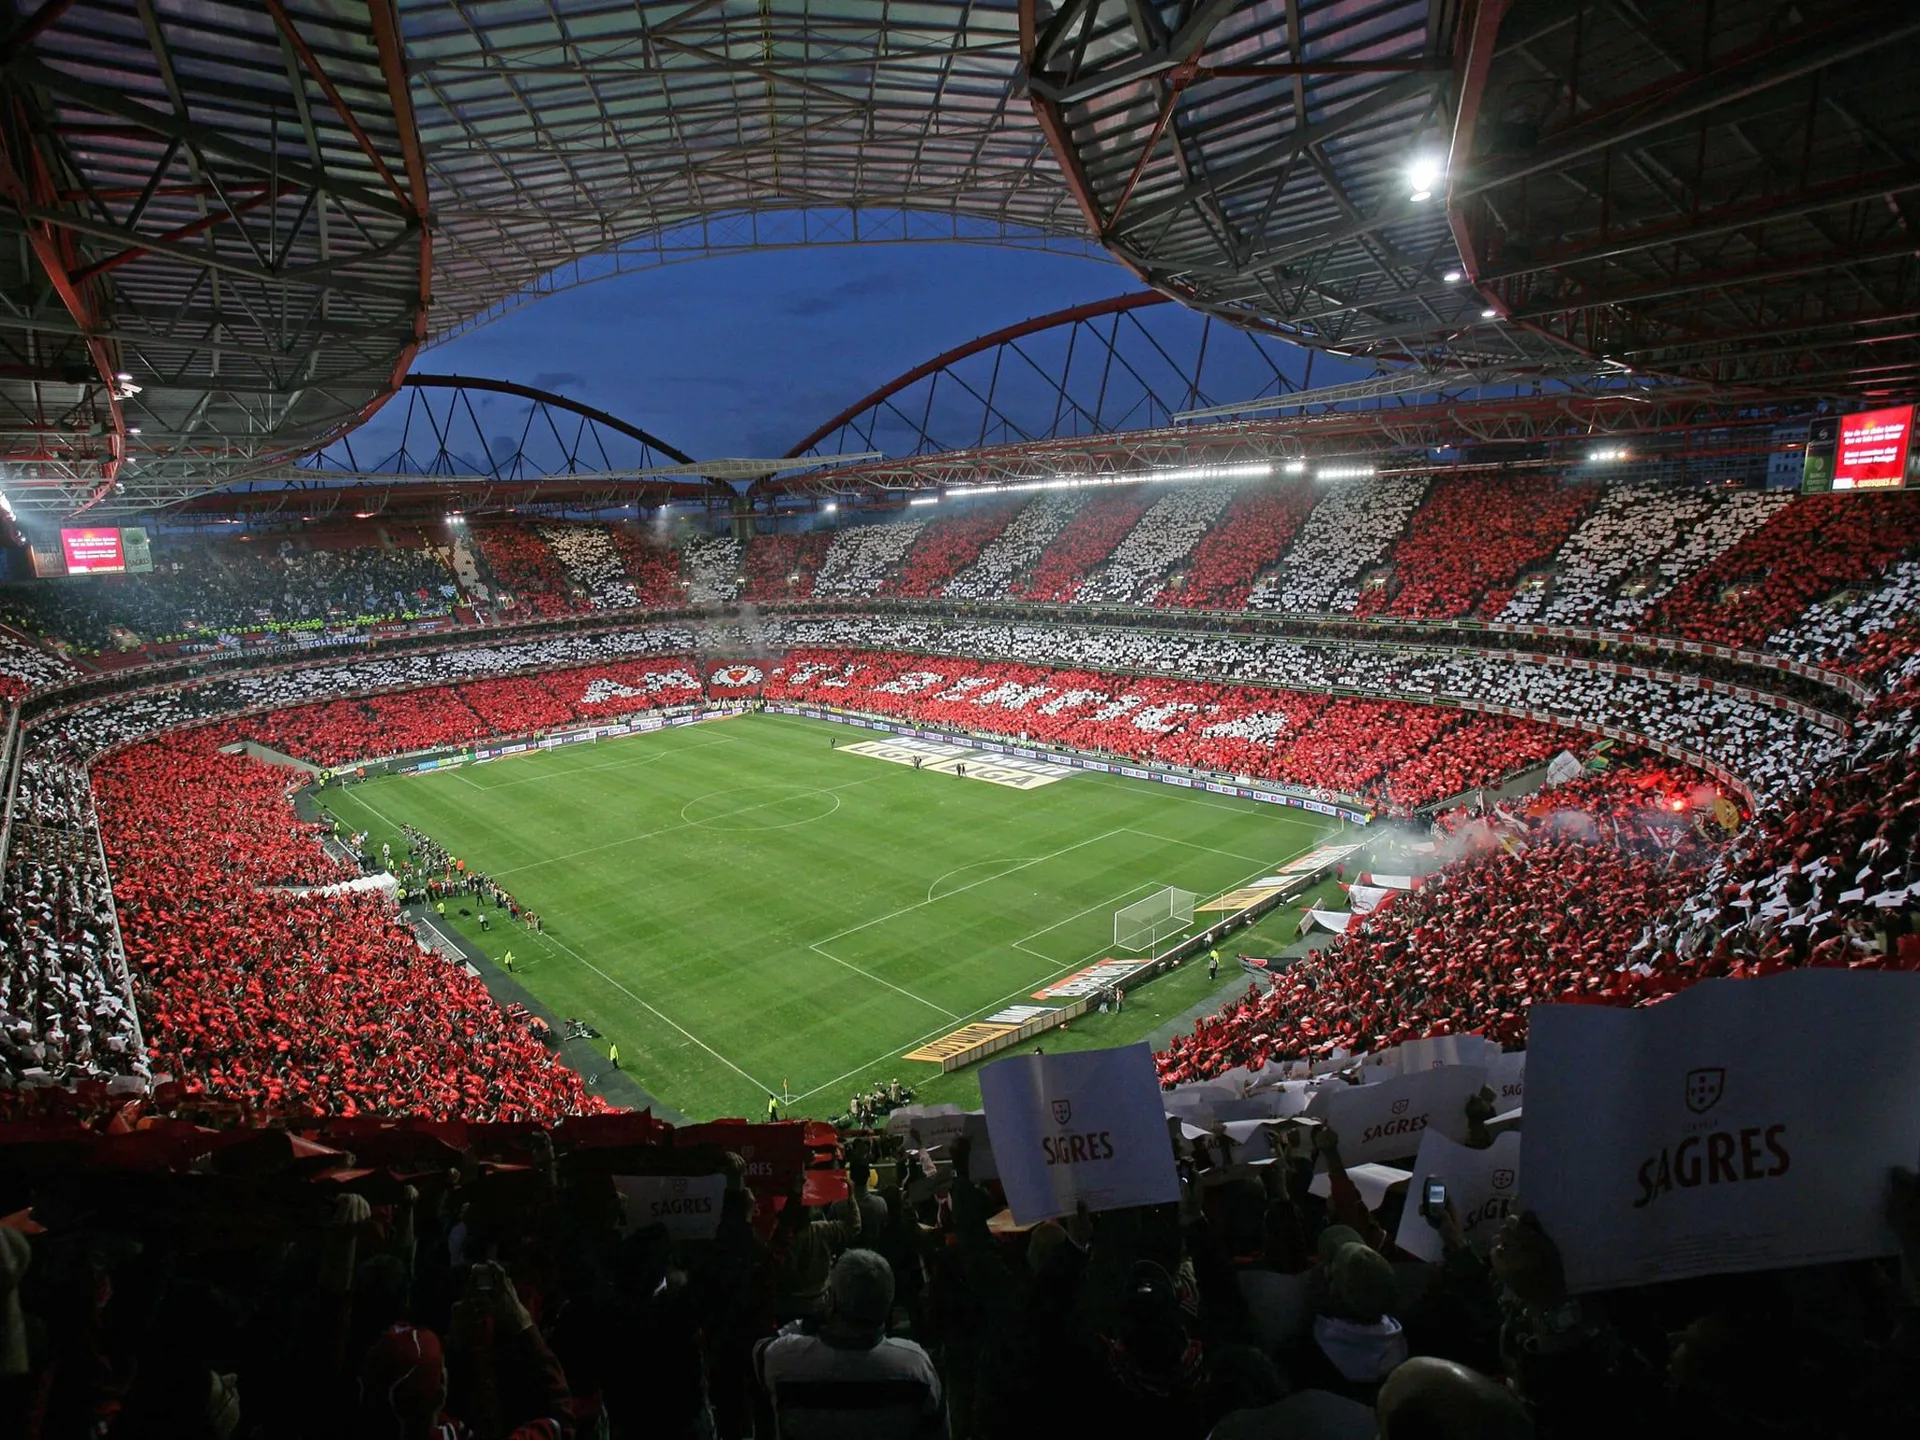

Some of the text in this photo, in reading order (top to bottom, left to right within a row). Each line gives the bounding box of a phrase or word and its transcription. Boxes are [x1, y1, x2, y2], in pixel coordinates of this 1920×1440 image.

[941, 763, 1037, 786] LIGA
[1502, 1084, 1522, 1097] SAG
[1361, 1112, 1429, 1143] SAGRES
[1043, 1131, 1113, 1165] SAGRES
[1633, 1123, 1791, 1208] SAGRES
[650, 1197, 712, 1218] SAGRES
